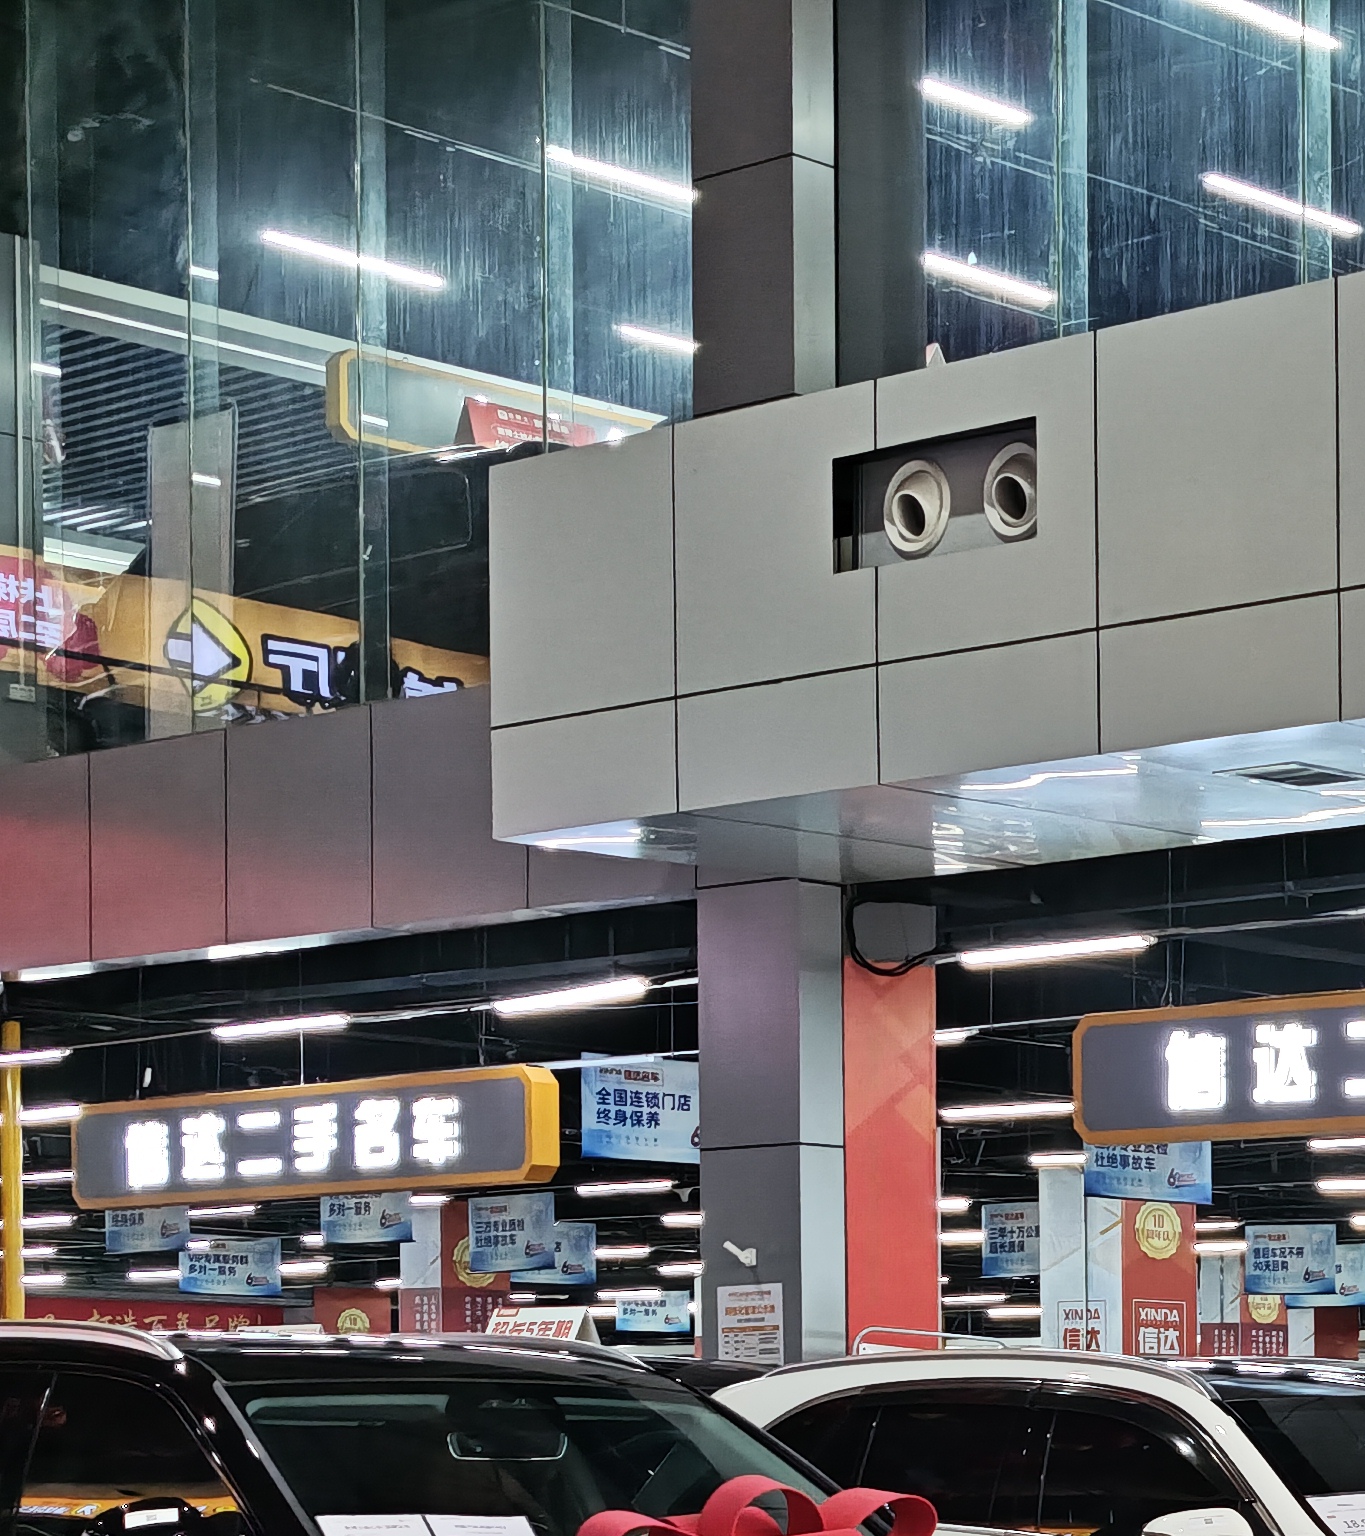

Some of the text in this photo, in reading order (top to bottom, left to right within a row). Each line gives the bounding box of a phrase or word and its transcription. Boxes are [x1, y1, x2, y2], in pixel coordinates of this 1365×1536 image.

[595, 1086, 692, 1112] 全国连锁门店
[595, 1107, 661, 1129] 终身保养
[1138, 1307, 1180, 1322] XINDA
[1137, 1327, 1180, 1355] 信达
